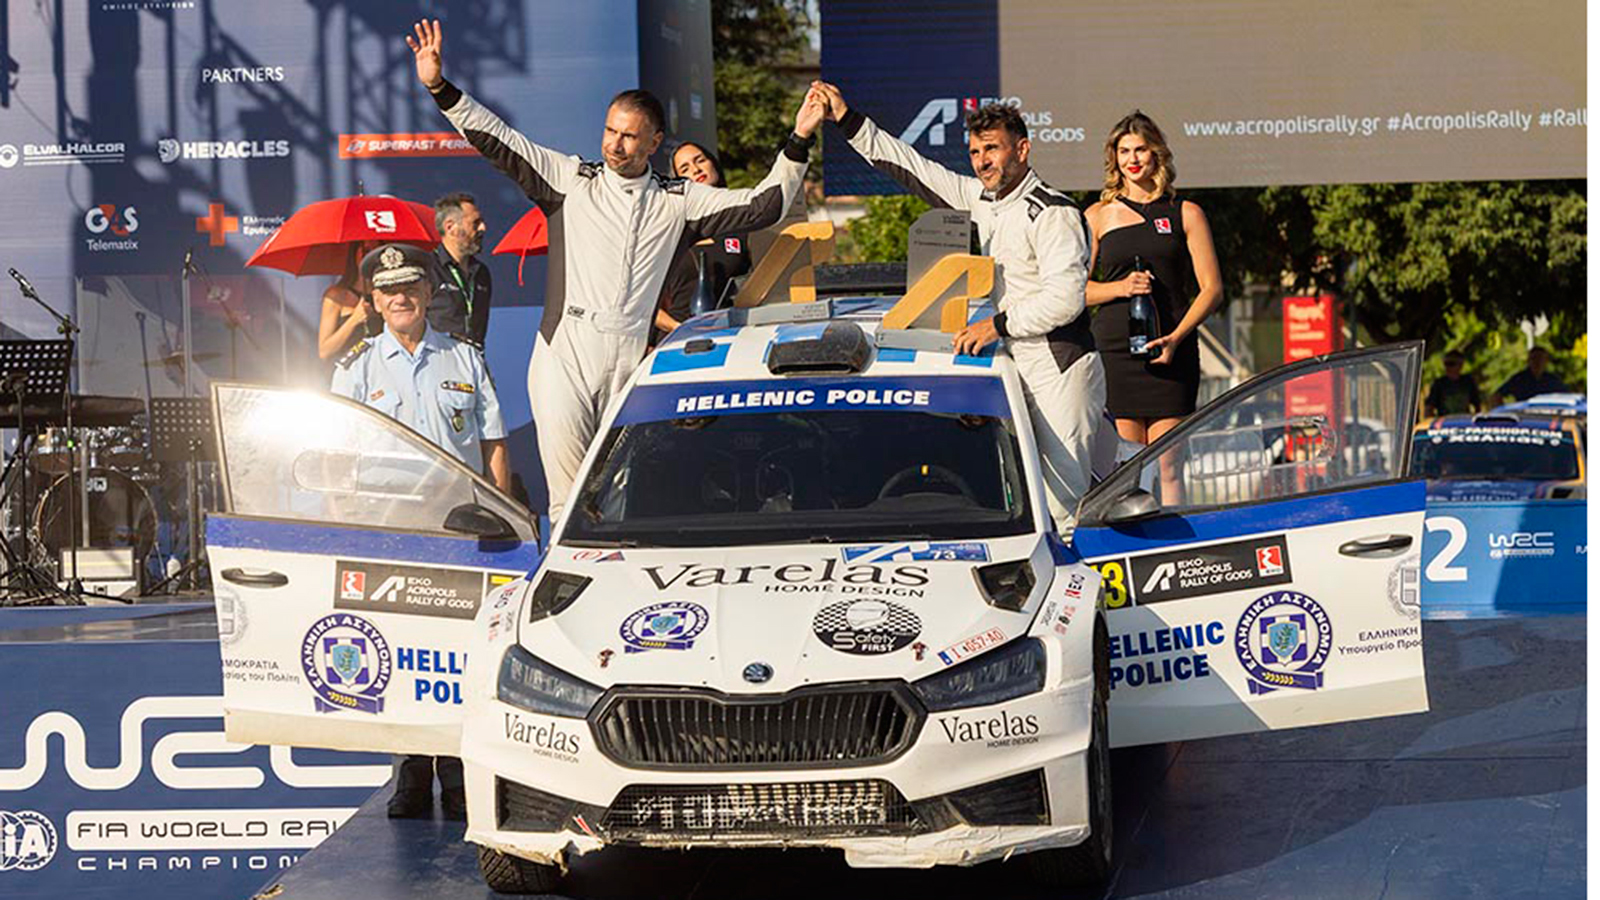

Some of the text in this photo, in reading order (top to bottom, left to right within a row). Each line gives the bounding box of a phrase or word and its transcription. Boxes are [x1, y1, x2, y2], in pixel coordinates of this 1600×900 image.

[202, 66, 284, 83] PARTNERS
[1183, 115, 1381, 137] www.acropolisrally.gr
[1387, 110, 1533, 133] #AcropolisRally
[1039, 127, 1086, 142] GODS
[182, 139, 291, 160] HERACLES
[367, 138, 474, 151] SUPERFAST FERR
[85, 204, 139, 236] G4S
[86, 239, 140, 252] Telematix
[676, 389, 931, 414] HELLENIC POLICE
[1424, 515, 1469, 583] 2
[1489, 532, 1555, 548] WRC
[932, 550, 958, 561] 73
[641, 558, 930, 592] Varelas
[1178, 562, 1233, 579] ACROPOLIS
[1180, 575, 1210, 589] RALLY
[1209, 573, 1223, 584] OF
[1224, 568, 1253, 582] GODS
[405, 585, 458, 598] ACROPOLIS
[763, 583, 926, 599] HOME DESIGN
[405, 594, 475, 610] RALLY OF GODS
[1279, 592, 1331, 664] ΑΣΤΥΝΟΜΙΑ
[1358, 626, 1419, 642] ΕΛΛΗΝΙΚΗ
[832, 631, 897, 650] Safety
[860, 643, 896, 652] FIRST
[1109, 621, 1226, 660] ELLENIC
[341, 615, 390, 690] ΑΣΤΥΝΟΜΙΑ
[396, 646, 468, 675] HELL
[225, 658, 279, 670] ΜΟΚΡΑΤΙΑ
[1109, 654, 1210, 690] POLICE
[503, 711, 581, 756] Varelas
[938, 709, 1040, 744] Varelas
[986, 736, 1040, 749] HOME DESIGN
[77, 822, 129, 838] FIA
[140, 820, 269, 838] WORLD
